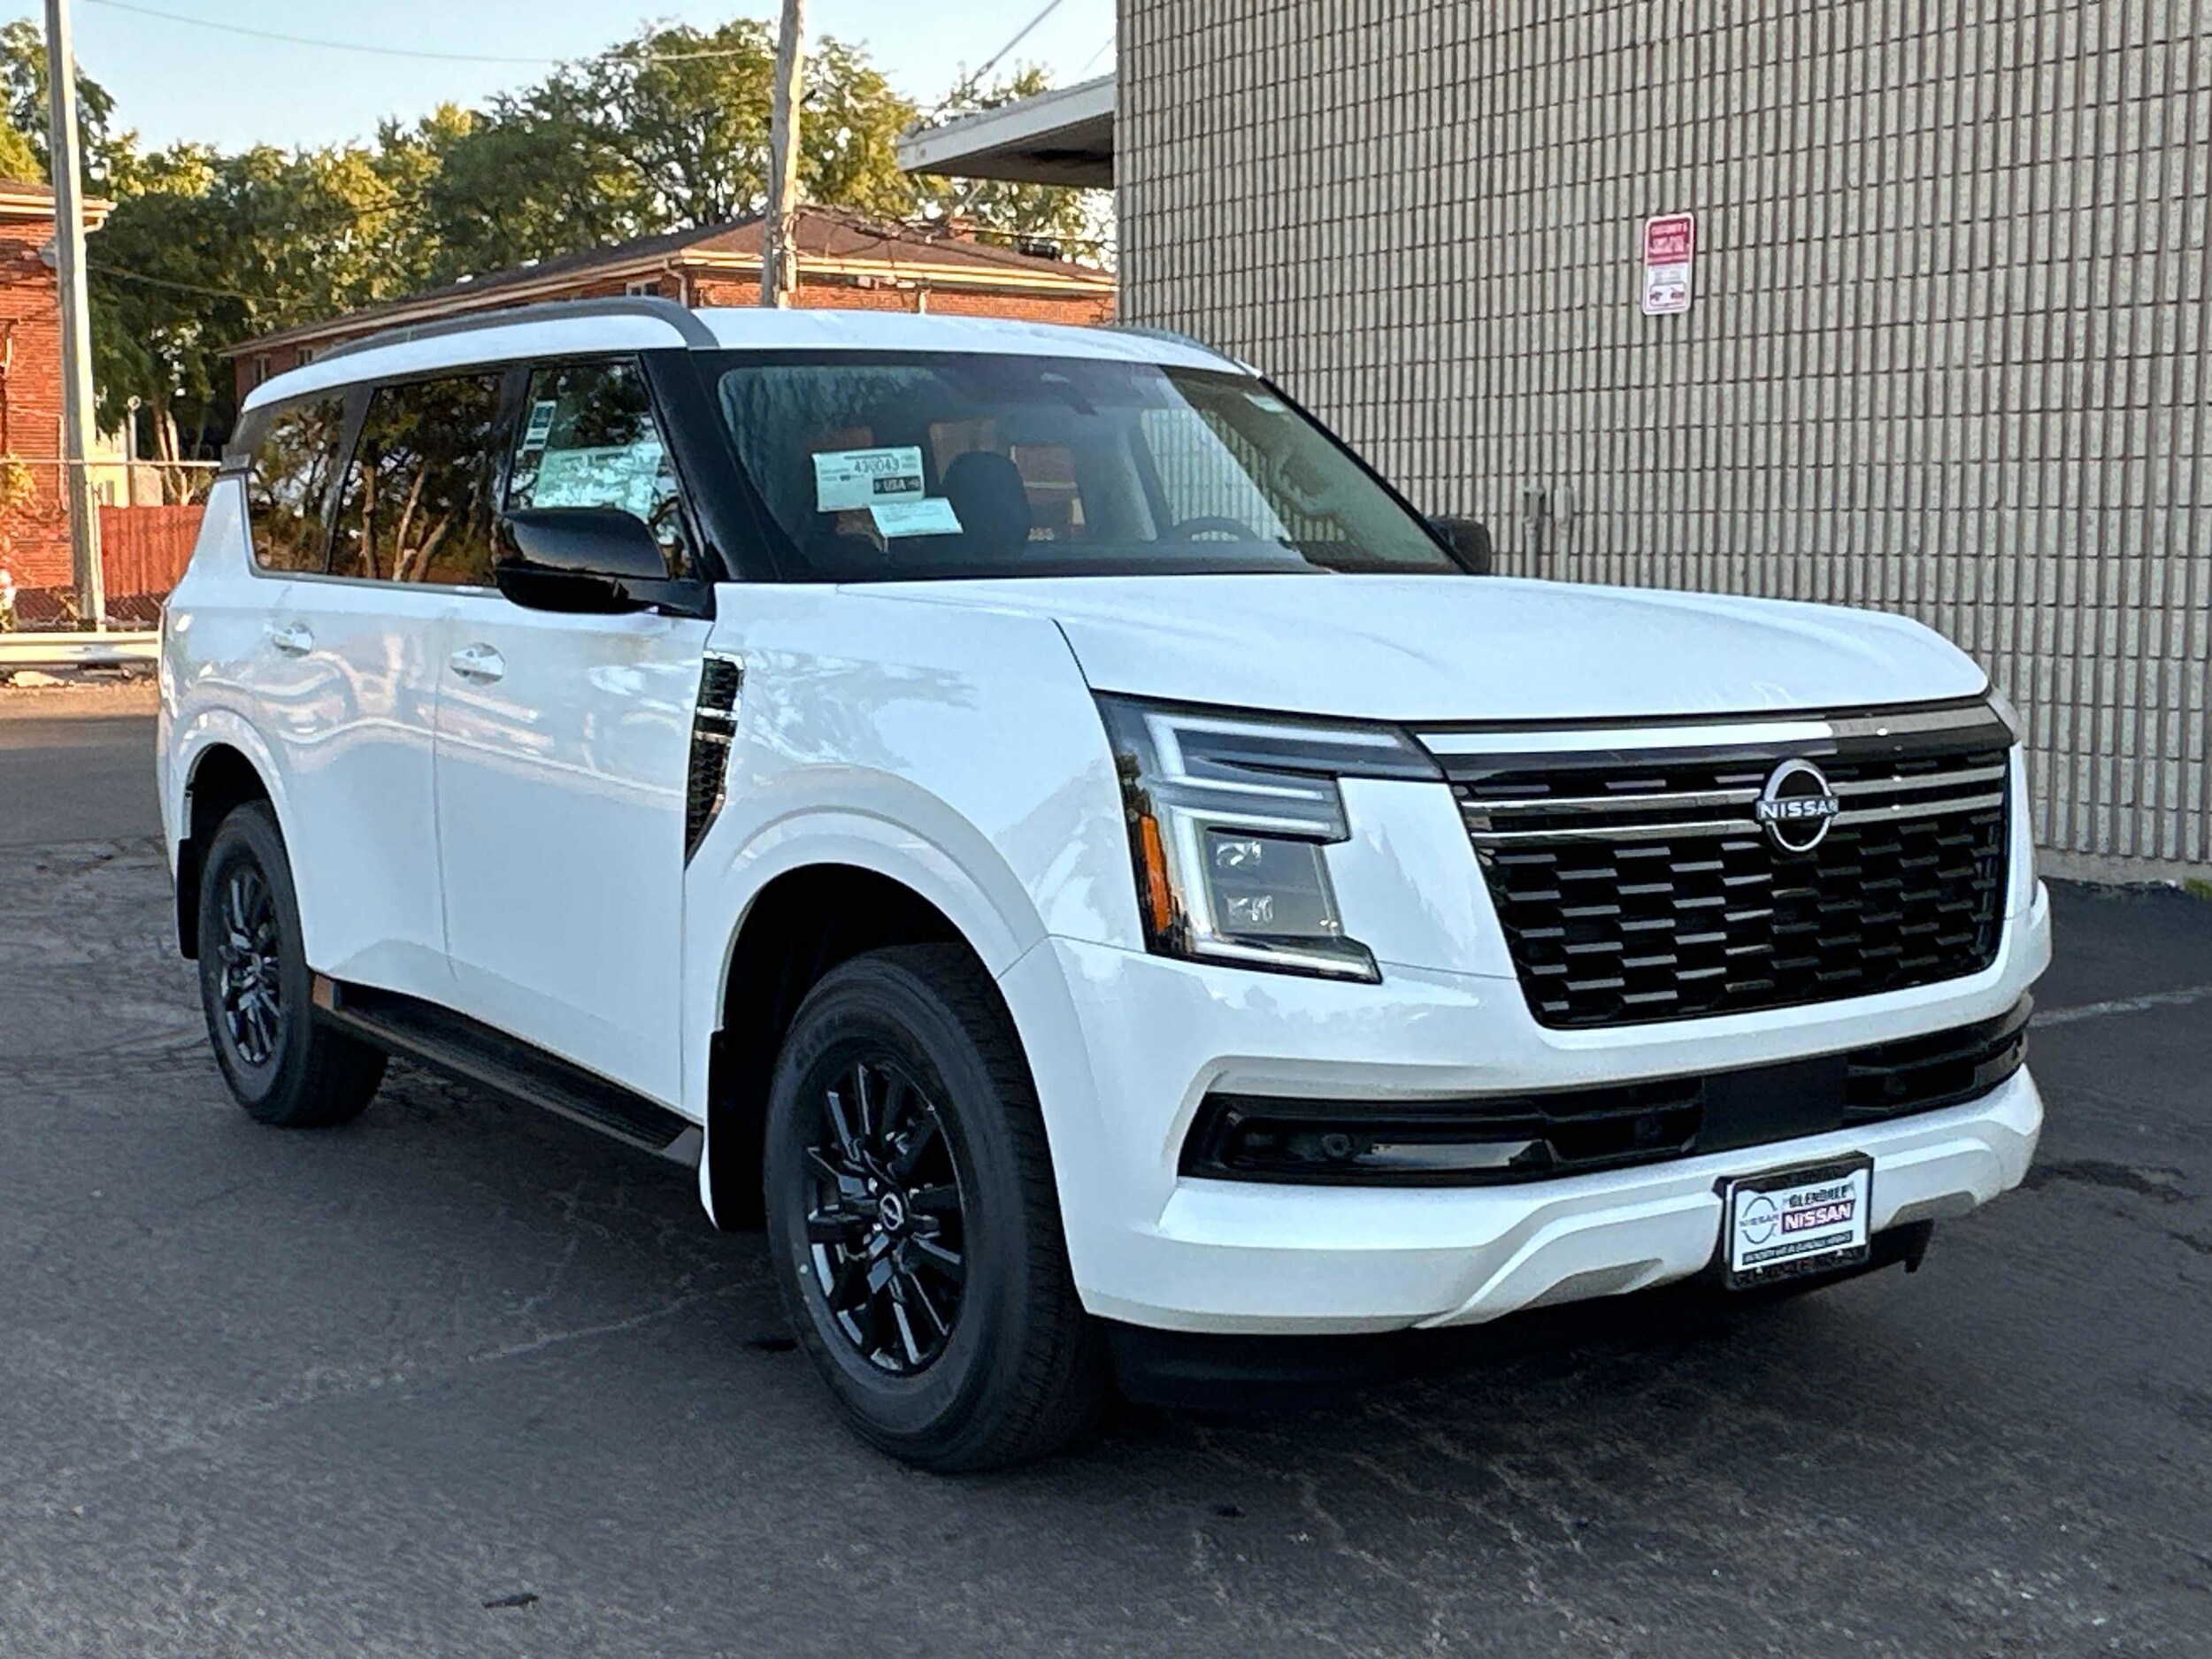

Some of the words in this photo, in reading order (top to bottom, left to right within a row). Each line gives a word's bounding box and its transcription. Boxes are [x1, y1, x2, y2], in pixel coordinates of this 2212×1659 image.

[883, 479, 906, 491] USA
[1760, 799, 1838, 819] NISSAN
[1785, 1202, 1851, 1230] NISSAN
